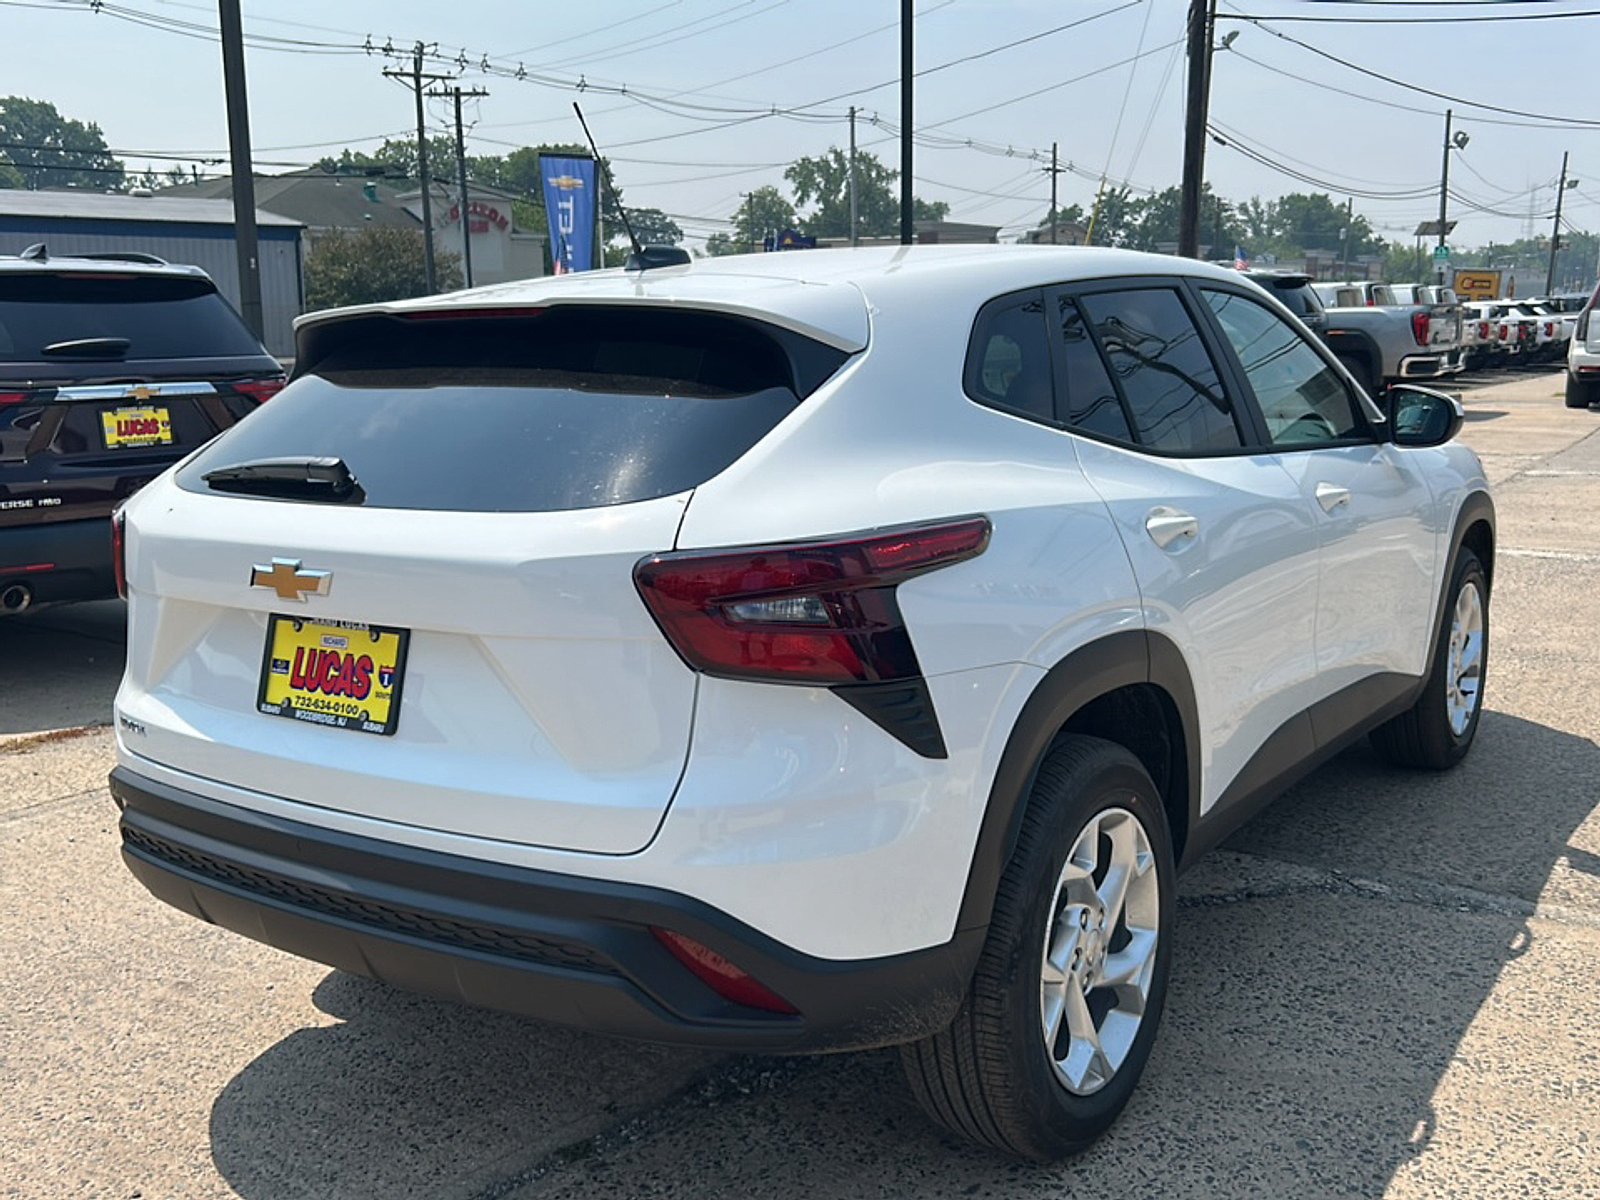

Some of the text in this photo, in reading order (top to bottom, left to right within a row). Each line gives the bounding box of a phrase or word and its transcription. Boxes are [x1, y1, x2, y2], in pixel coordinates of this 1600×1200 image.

[116, 418, 160, 437] LUCAS
[0, 499, 34, 510] ERSE
[290, 646, 375, 701] LUCAS
[294, 694, 360, 716] 732-634-0100
